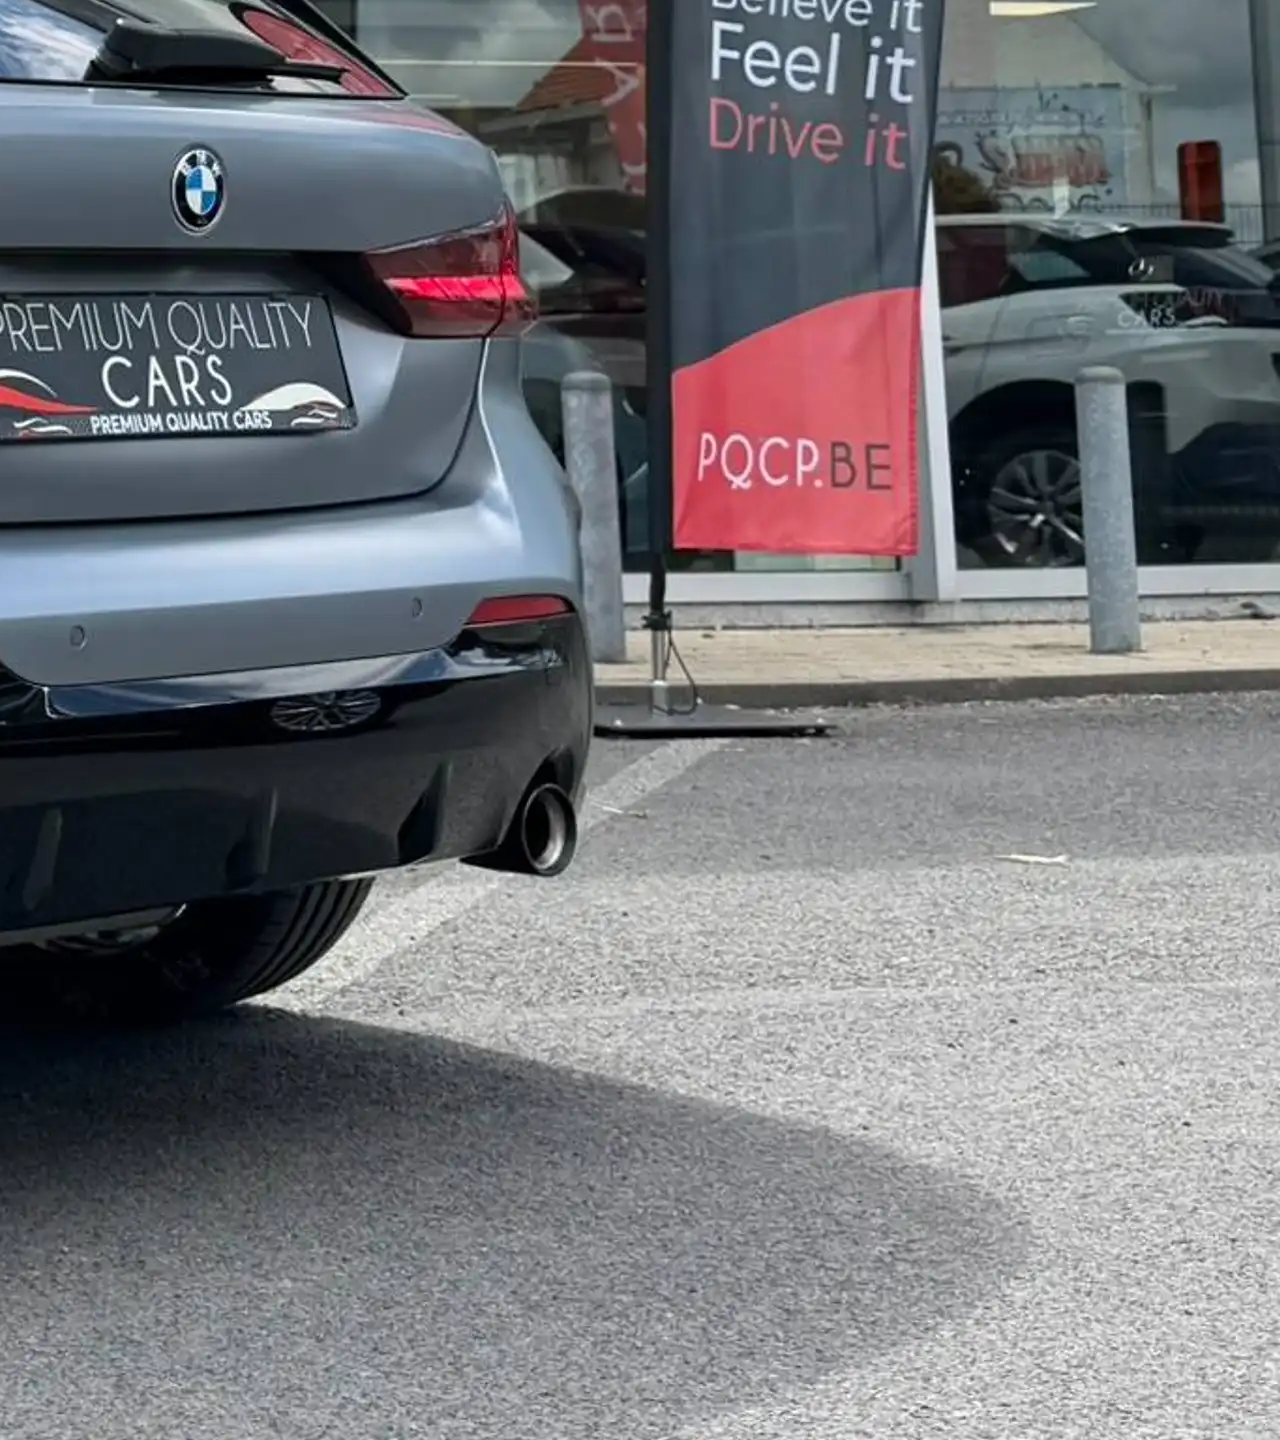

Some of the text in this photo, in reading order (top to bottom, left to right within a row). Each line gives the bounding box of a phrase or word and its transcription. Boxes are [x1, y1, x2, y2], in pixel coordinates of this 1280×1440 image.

[711, 20, 917, 103] Feel it
[710, 97, 844, 163] Drive
[864, 113, 907, 169] it
[167, 301, 313, 356] QUALITY
[101, 355, 233, 408] CARS
[90, 410, 272, 435] PREMIUM QUALITY CARS
[698, 432, 893, 490] PQCP.BE
